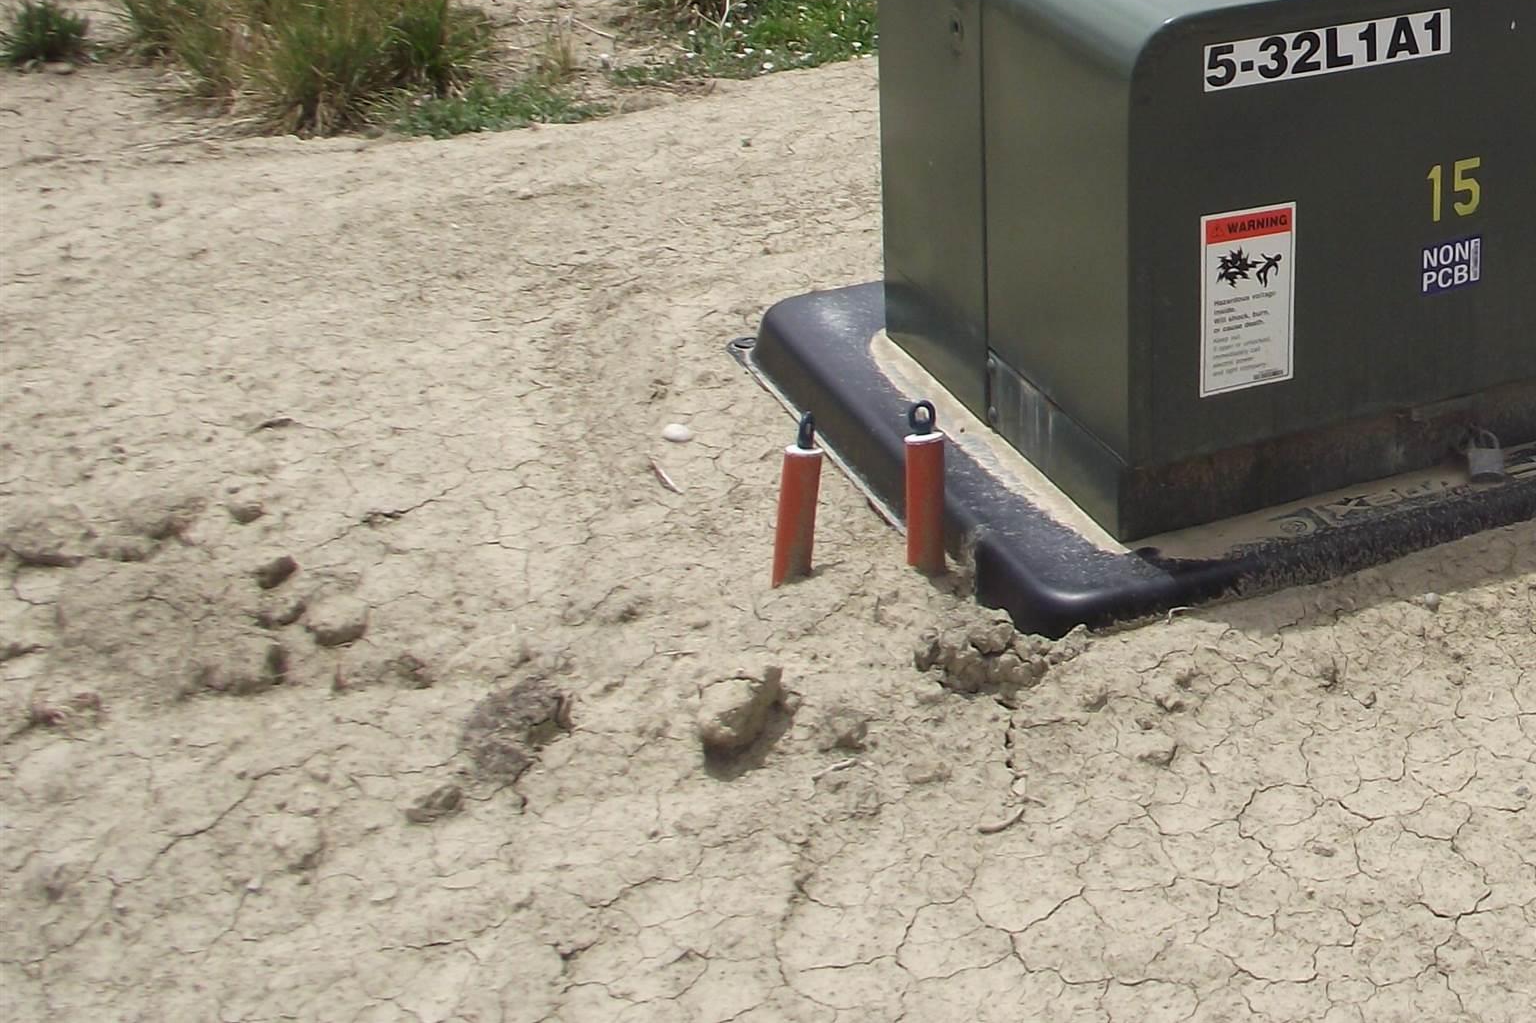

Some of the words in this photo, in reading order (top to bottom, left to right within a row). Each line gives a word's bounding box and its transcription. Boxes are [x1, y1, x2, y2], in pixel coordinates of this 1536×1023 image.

[1205, 12, 1442, 87] 5-32L1A1
[1427, 156, 1481, 222] 15
[1227, 214, 1288, 234] WARNING
[1423, 240, 1469, 270] NON
[1422, 264, 1469, 292] PCB
